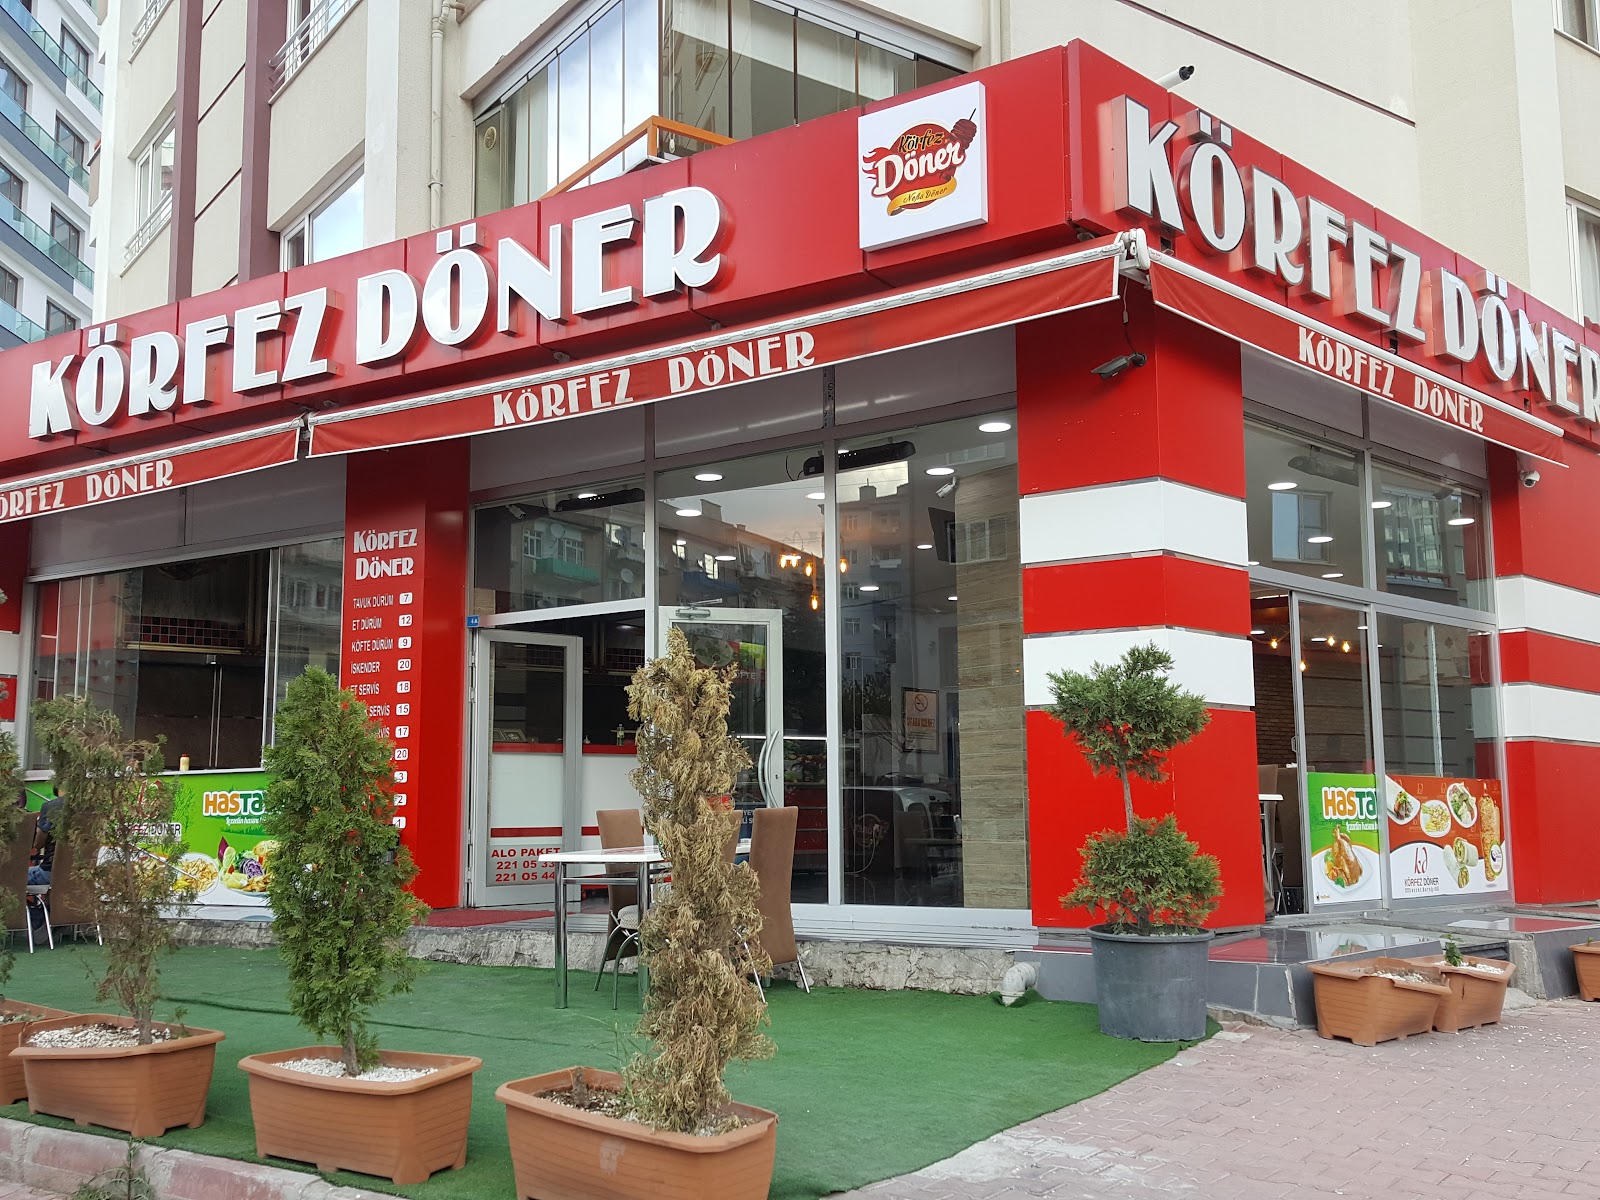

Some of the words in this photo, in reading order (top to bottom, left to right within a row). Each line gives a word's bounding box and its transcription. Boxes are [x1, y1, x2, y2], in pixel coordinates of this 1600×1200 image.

[898, 129, 944, 153] Körfez
[873, 141, 965, 196] Döner
[925, 187, 948, 199] Döner
[1125, 95, 1426, 343] KÖRFEZ
[29, 287, 328, 438] KÖRFEZ
[356, 186, 721, 365] DÖNER
[493, 369, 633, 426] KÖRFEZ
[668, 332, 815, 394] DÖNER
[1300, 327, 1394, 398] KÖRFEZ
[1414, 376, 1484, 433] DÖNER
[86, 459, 174, 502] DÖNER
[353, 528, 418, 553] KÖRFEZ
[355, 557, 414, 580] DÖNER
[353, 597, 372, 609] TAVUK
[372, 593, 394, 607] DÜRÜM
[352, 620, 360, 631] ET
[361, 616, 382, 630] DÜRÜM
[401, 615, 411, 625] 12
[351, 639, 371, 652] KÖFTE
[372, 637, 394, 651] DÜRÜM
[350, 661, 380, 675] İSKENDER
[399, 660, 410, 669] 20
[358, 681, 380, 696] SERVİS
[398, 682, 410, 692] 18
[369, 702, 391, 716] SERVİS
[398, 705, 409, 714] 15
[397, 727, 408, 736] 17
[396, 749, 407, 758] 20
[491, 849, 517, 858] ALO
[520, 847, 561, 857] PAKET
[496, 860, 518, 870] 221
[522, 860, 537, 869] 05
[495, 872, 517, 882] 221
[541, 871, 555, 880] 44
[1404, 877, 1423, 887] KÖRFEZ
[1423, 876, 1440, 886] DÖNER
